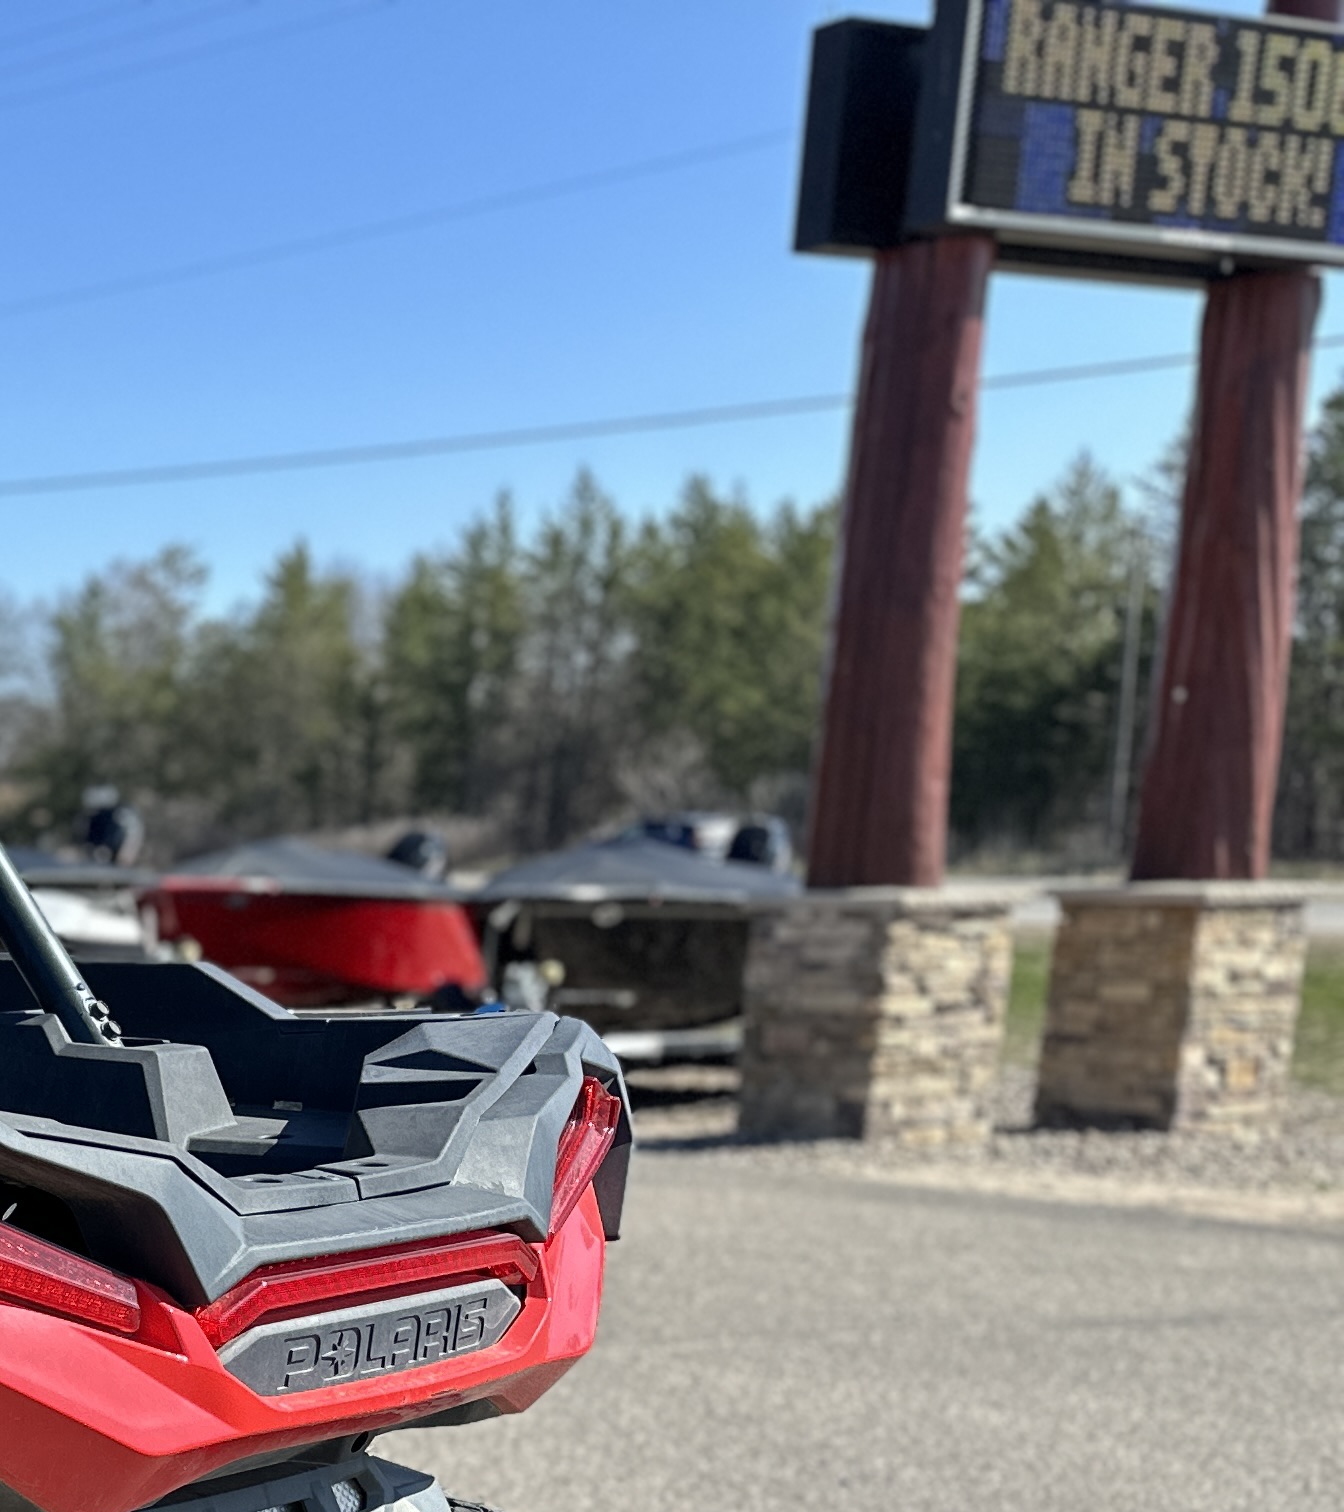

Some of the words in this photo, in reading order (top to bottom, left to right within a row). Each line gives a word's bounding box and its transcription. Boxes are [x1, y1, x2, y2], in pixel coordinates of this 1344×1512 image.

[1002, 1, 1219, 118] RANGER
[1069, 107, 1140, 208] IN
[1148, 119, 1333, 228] STOCK!
[277, 1298, 488, 1391] POLARIS
